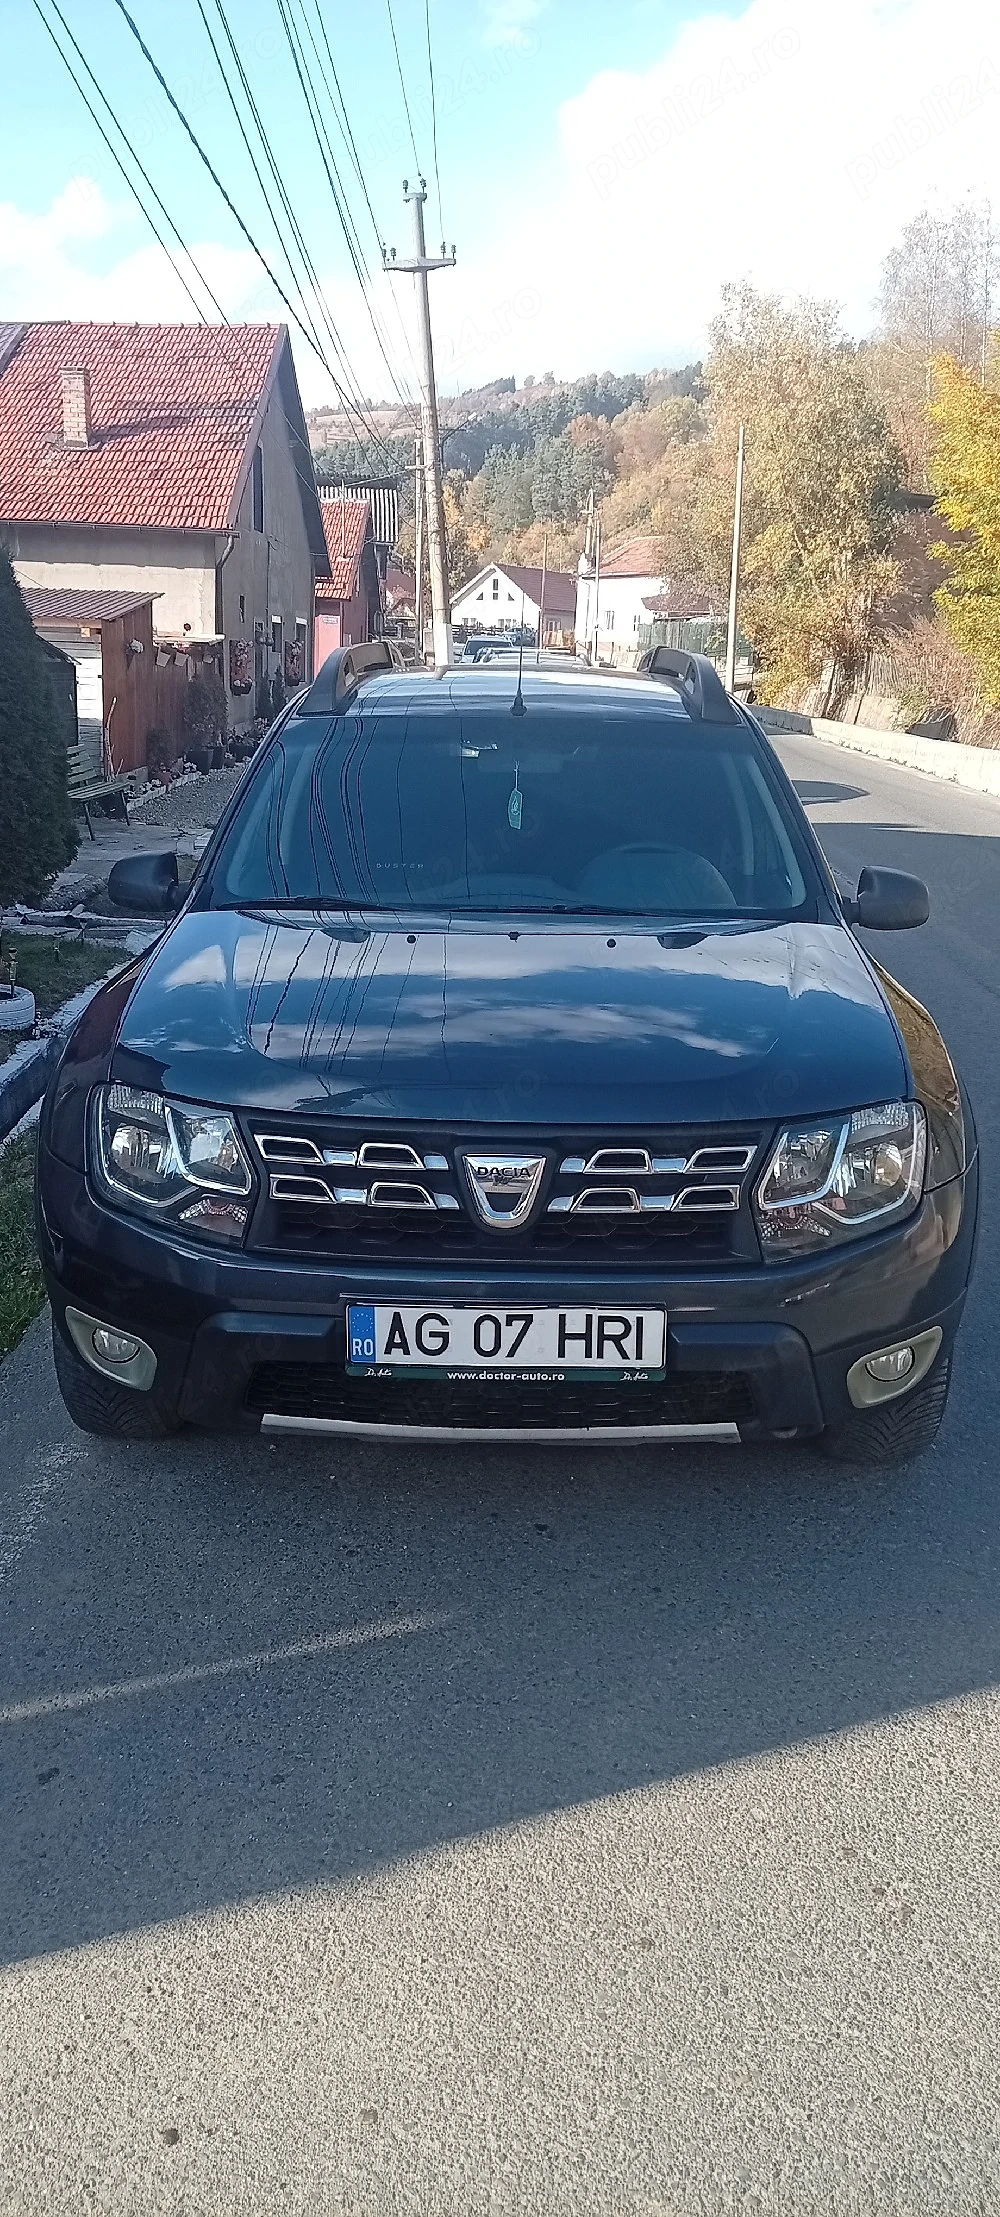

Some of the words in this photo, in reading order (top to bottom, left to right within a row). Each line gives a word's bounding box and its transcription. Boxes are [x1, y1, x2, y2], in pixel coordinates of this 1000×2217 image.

[477, 1166, 531, 1177] DACIA
[383, 1311, 450, 1356] AG
[473, 1313, 534, 1358] 07
[557, 1313, 644, 1360] HRI
[352, 1338, 374, 1356] RO
[447, 1370, 565, 1381] www.doctor-auto.ro
